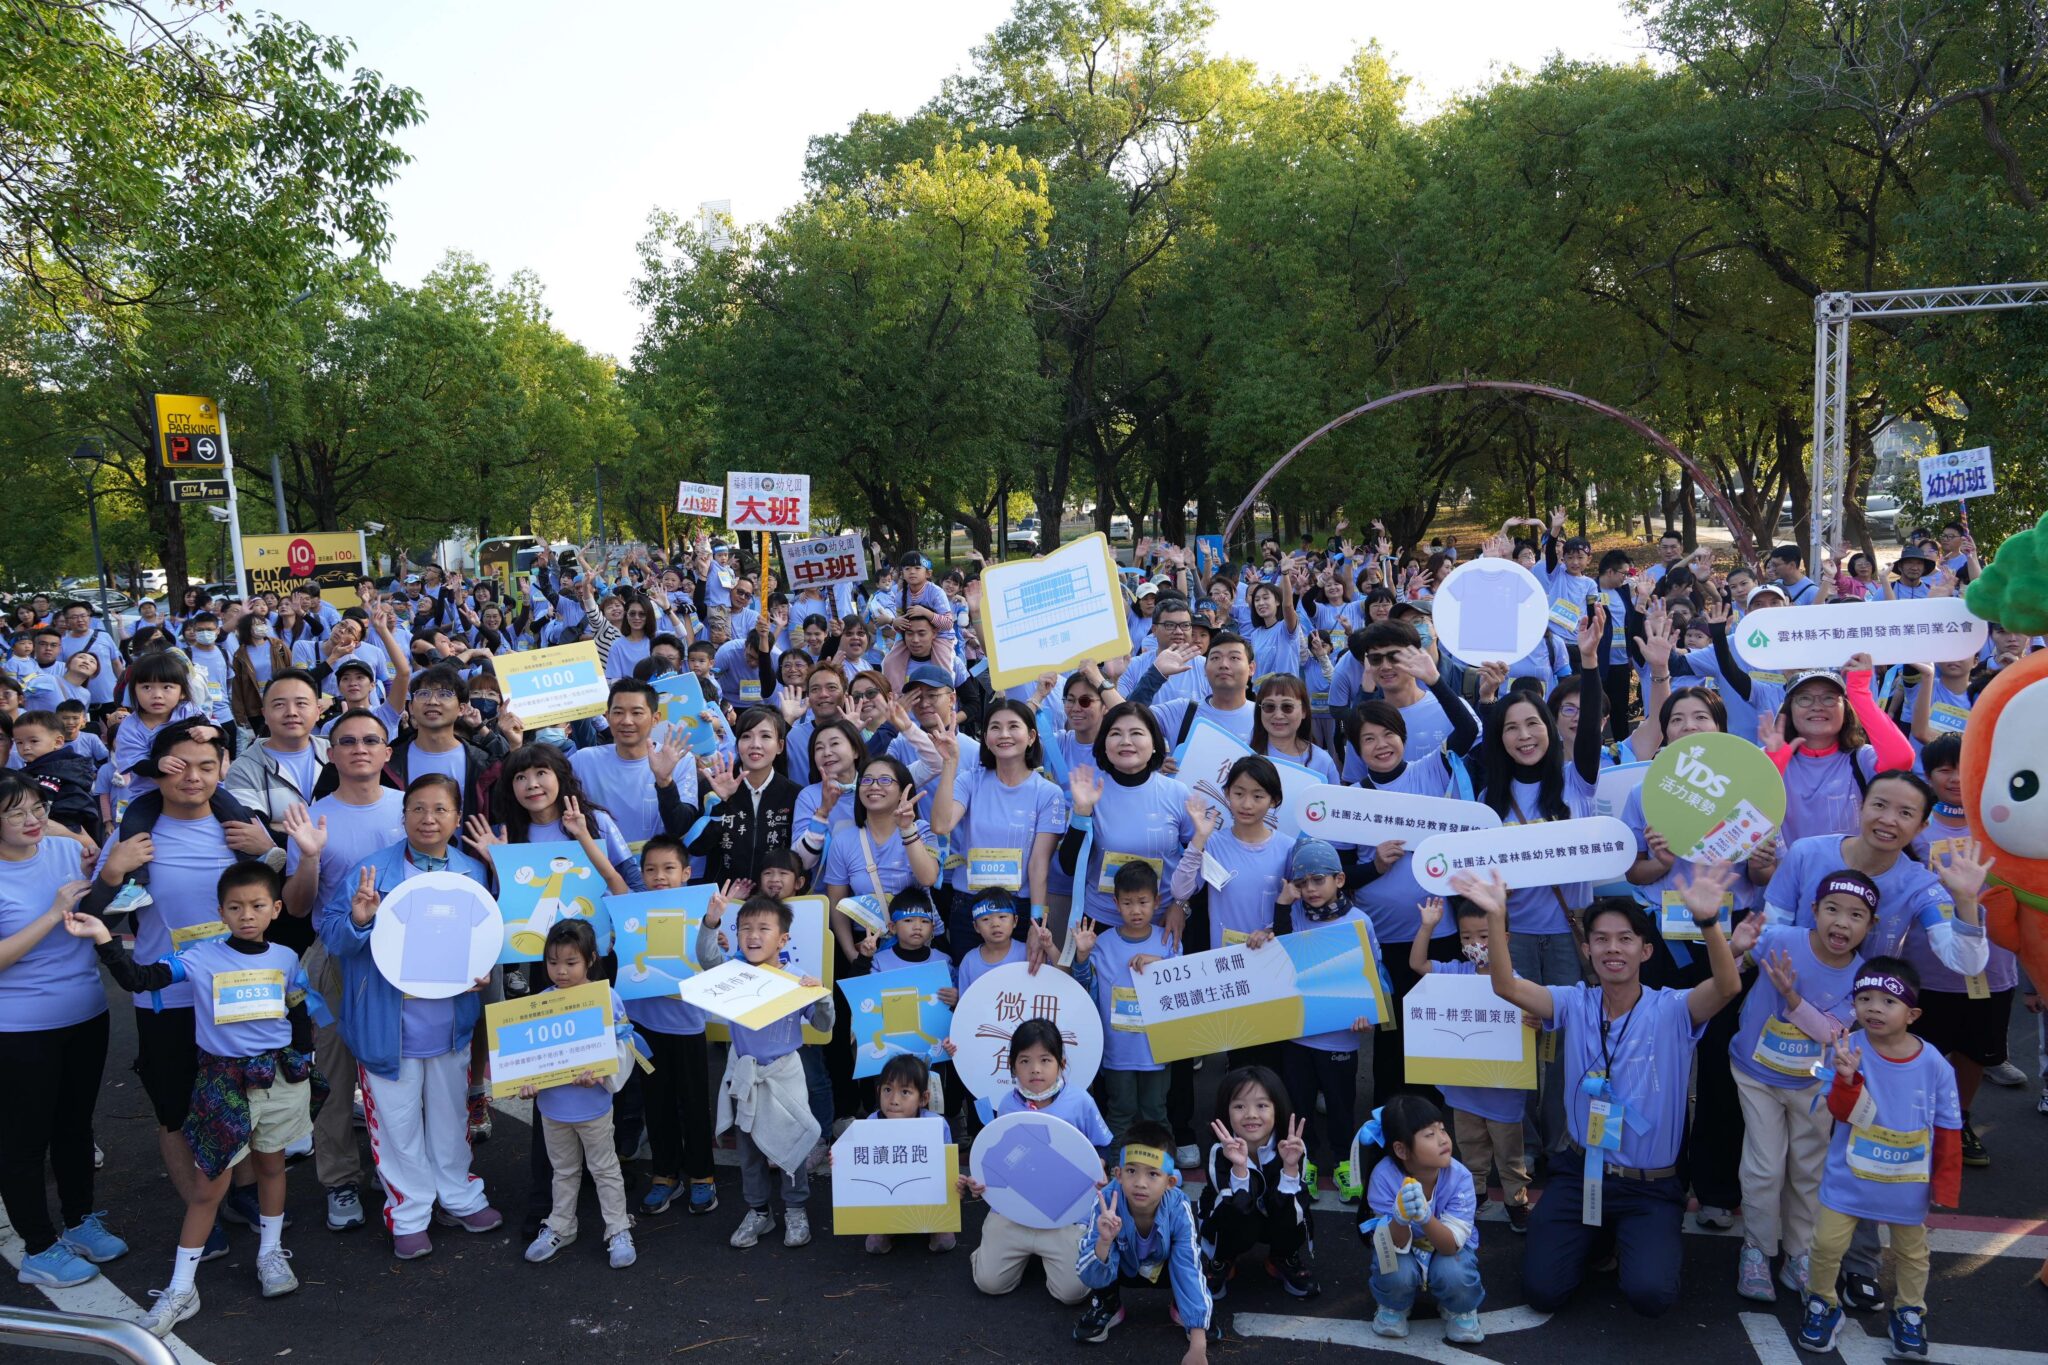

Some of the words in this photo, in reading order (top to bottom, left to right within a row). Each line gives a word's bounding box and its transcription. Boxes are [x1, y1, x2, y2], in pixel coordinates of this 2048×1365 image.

[167, 413, 191, 423] CITY
[169, 424, 216, 434] PARKING
[171, 436, 189, 461] P
[776, 479, 802, 492] 幼兒園
[1927, 466, 1987, 498] 幼幼班
[683, 495, 718, 513] 小班
[735, 495, 801, 526] 大班
[829, 538, 855, 552] 幼兒園
[291, 546, 310, 564] 10
[335, 550, 352, 561] 100
[252, 567, 282, 581] CITY
[794, 554, 859, 583] 中班
[1777, 621, 1974, 642] 雲林縣不動產開發商業同業公會
[532, 670, 575, 689] 1000
[1674, 752, 1731, 798] VDS
[1658, 776, 1717, 816] 活力東勢
[1452, 840, 1625, 869] 社團法人雲林縣幼兒教育發展協會
[981, 864, 1005, 872] 0002
[1830, 881, 1864, 896] Frobel
[1153, 965, 1191, 985] 2025
[1214, 953, 1245, 974] 微冊
[1854, 976, 1883, 991] robel
[236, 987, 270, 999] 0533
[1159, 979, 1251, 1012] 愛閱讀生活節
[995, 991, 1061, 1024] 微冊
[1410, 1006, 1517, 1024] 微冊-耕雲圖策展
[524, 1019, 576, 1044] 1000
[1779, 1042, 1809, 1054] 0601
[853, 1144, 928, 1165] 閱讀路跑
[1873, 1147, 1910, 1161] 0600
